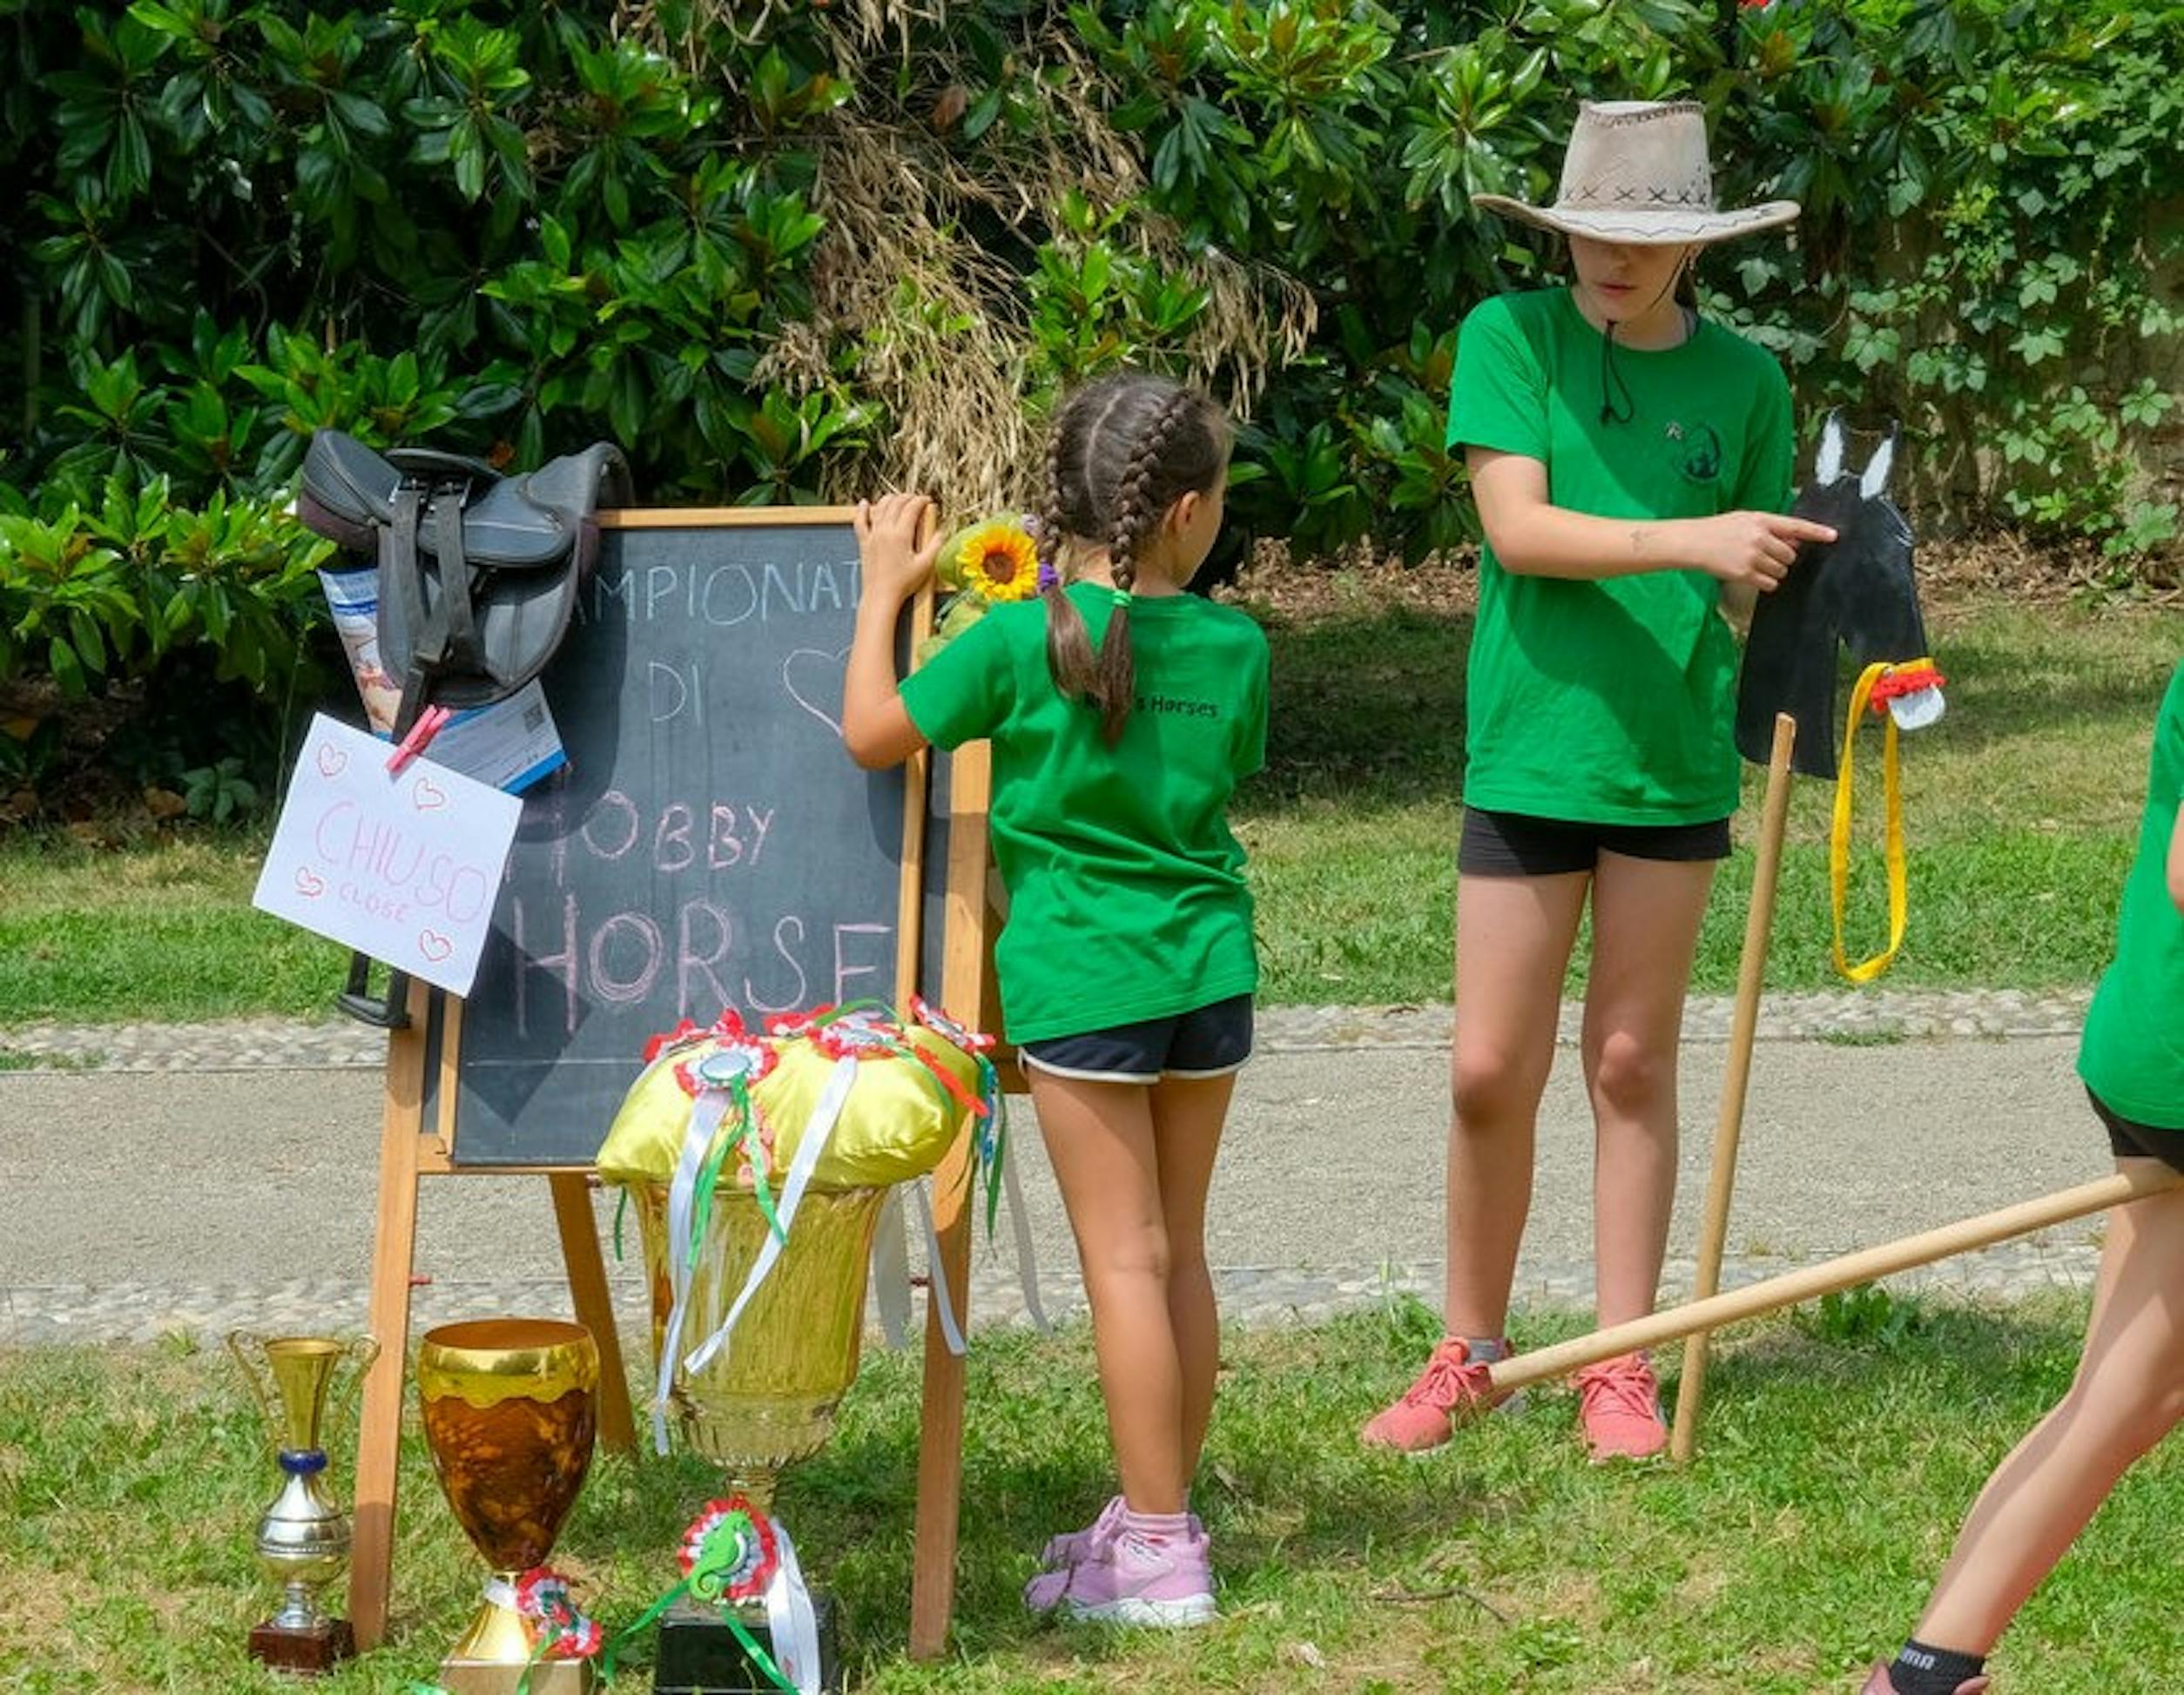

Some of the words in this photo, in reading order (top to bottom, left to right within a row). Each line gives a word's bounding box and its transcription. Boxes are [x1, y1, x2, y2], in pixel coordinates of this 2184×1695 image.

[648, 659, 702, 725] DI
[1151, 696, 1218, 718] Horses
[315, 800, 487, 923] CHIUSO
[340, 882, 407, 923] CLOSE
